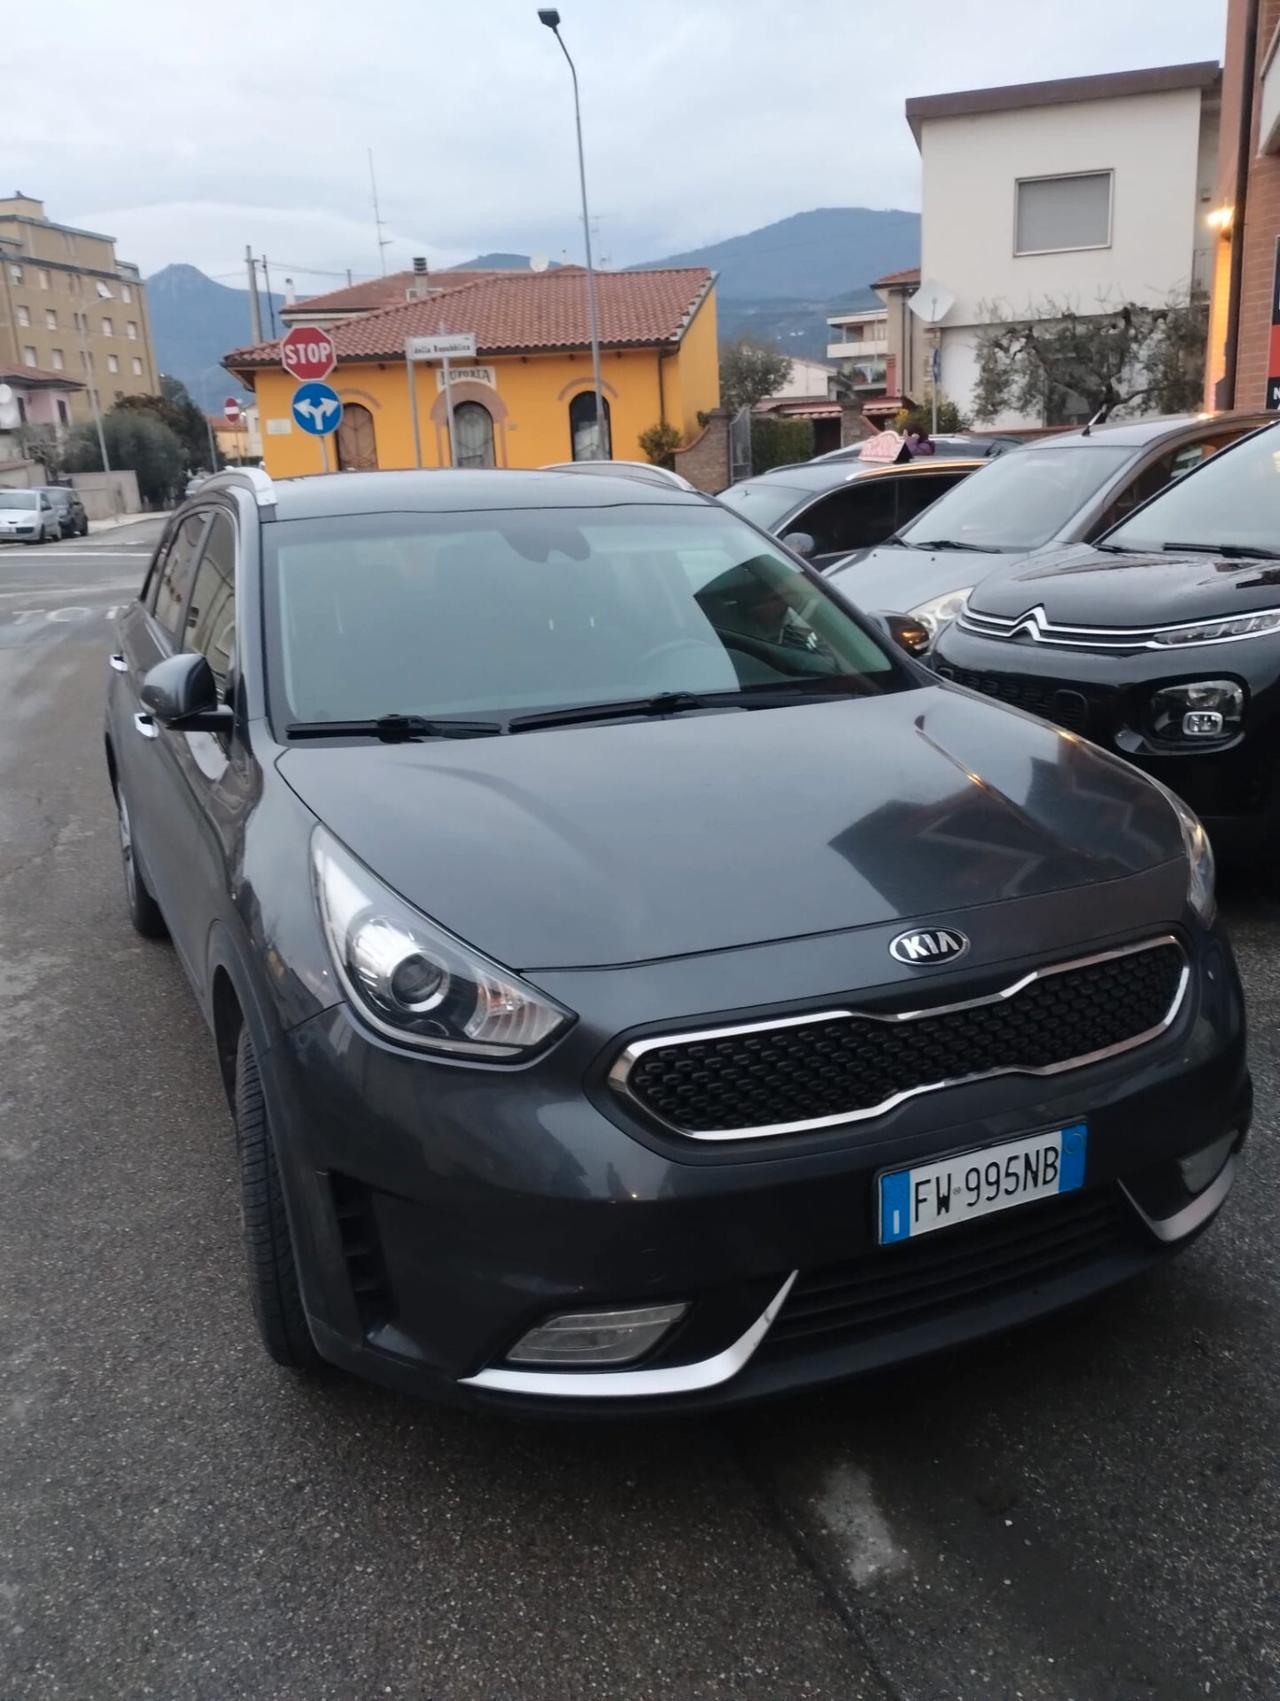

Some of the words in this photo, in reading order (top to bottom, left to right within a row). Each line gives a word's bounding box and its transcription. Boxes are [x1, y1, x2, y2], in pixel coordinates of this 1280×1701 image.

[284, 342, 331, 365] STOP
[900, 931, 960, 959] KIA
[914, 1173, 952, 1223] FW
[963, 1145, 1061, 1207] 995NB
